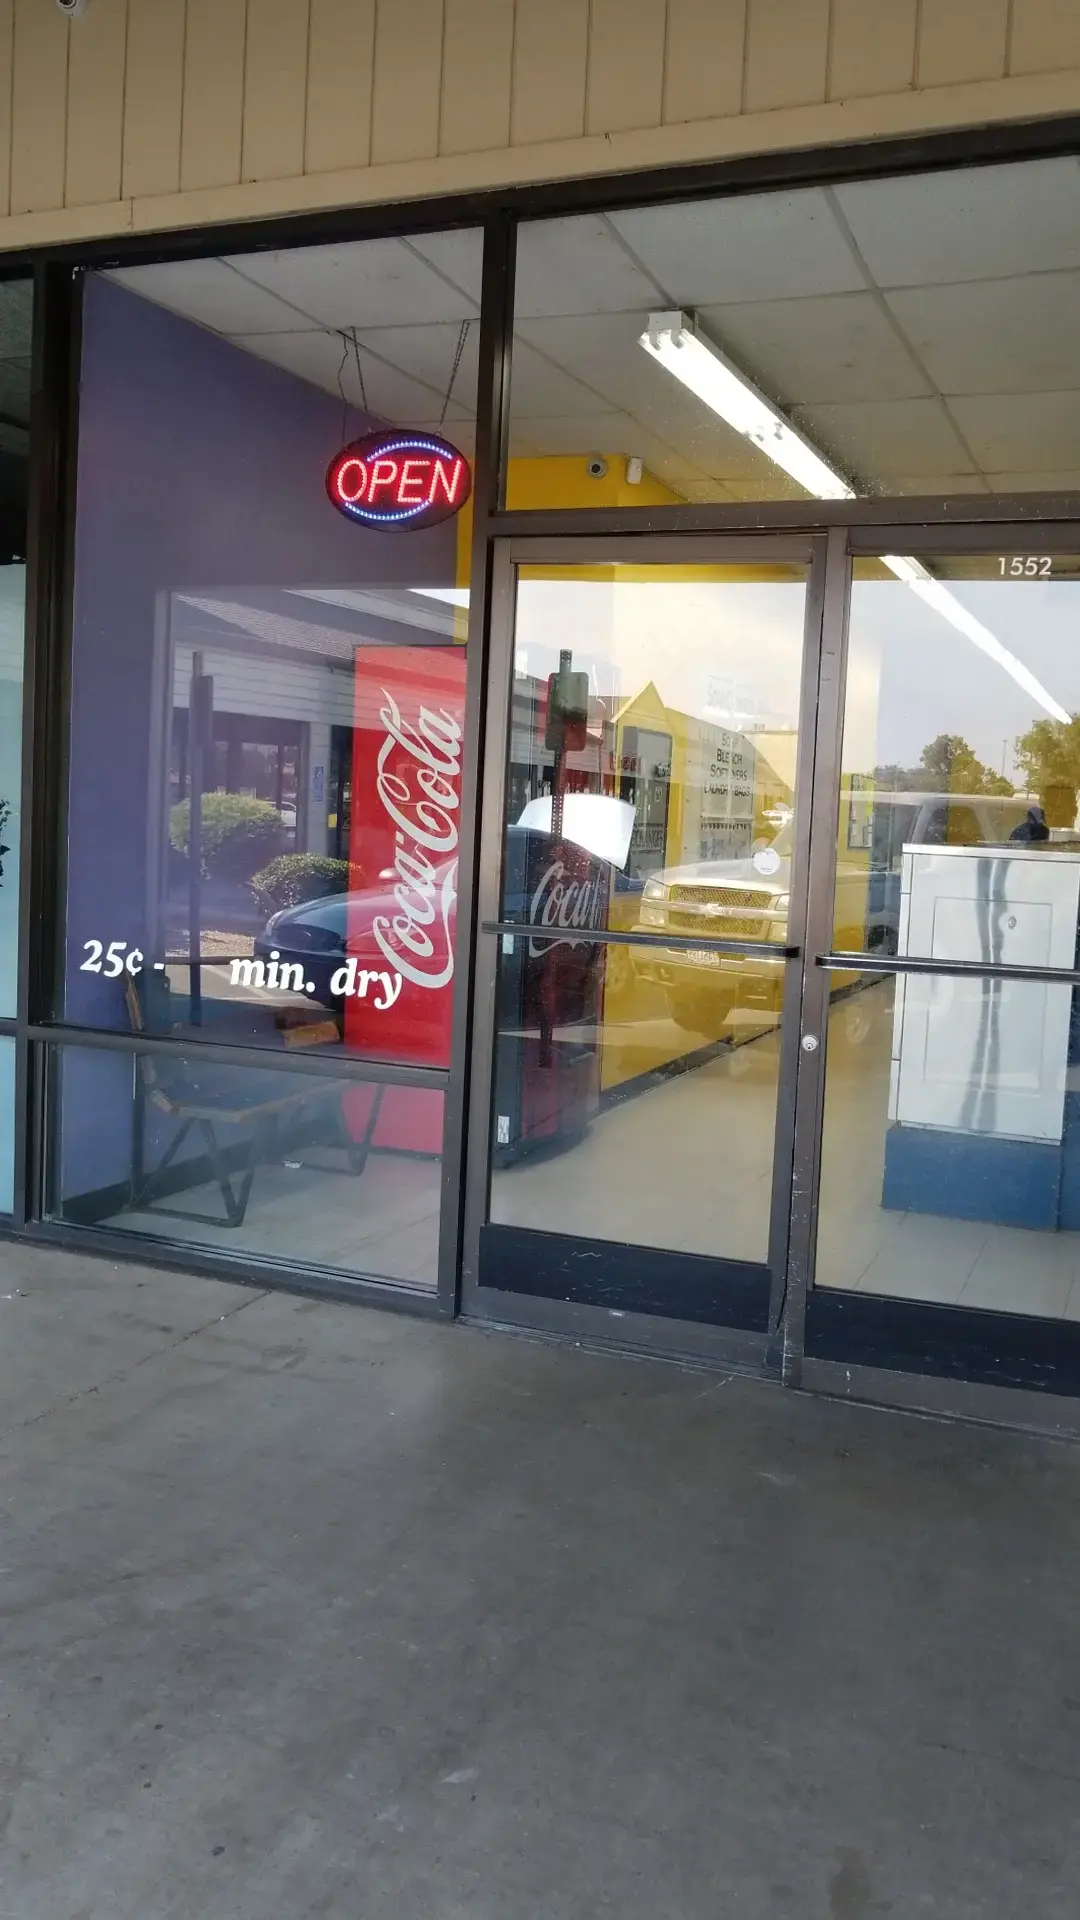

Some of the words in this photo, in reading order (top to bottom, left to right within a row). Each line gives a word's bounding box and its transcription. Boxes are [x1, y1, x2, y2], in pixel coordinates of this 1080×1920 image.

[337, 459, 462, 503] OPEN
[998, 557, 1052, 576] 1552
[721, 732, 739, 749] SOP
[710, 764, 748, 782] SOFTNERS
[704, 782, 732, 797] LAUNDR
[80, 939, 144, 978] 25¢
[229, 950, 316, 993] min.
[330, 957, 403, 1010] dry
